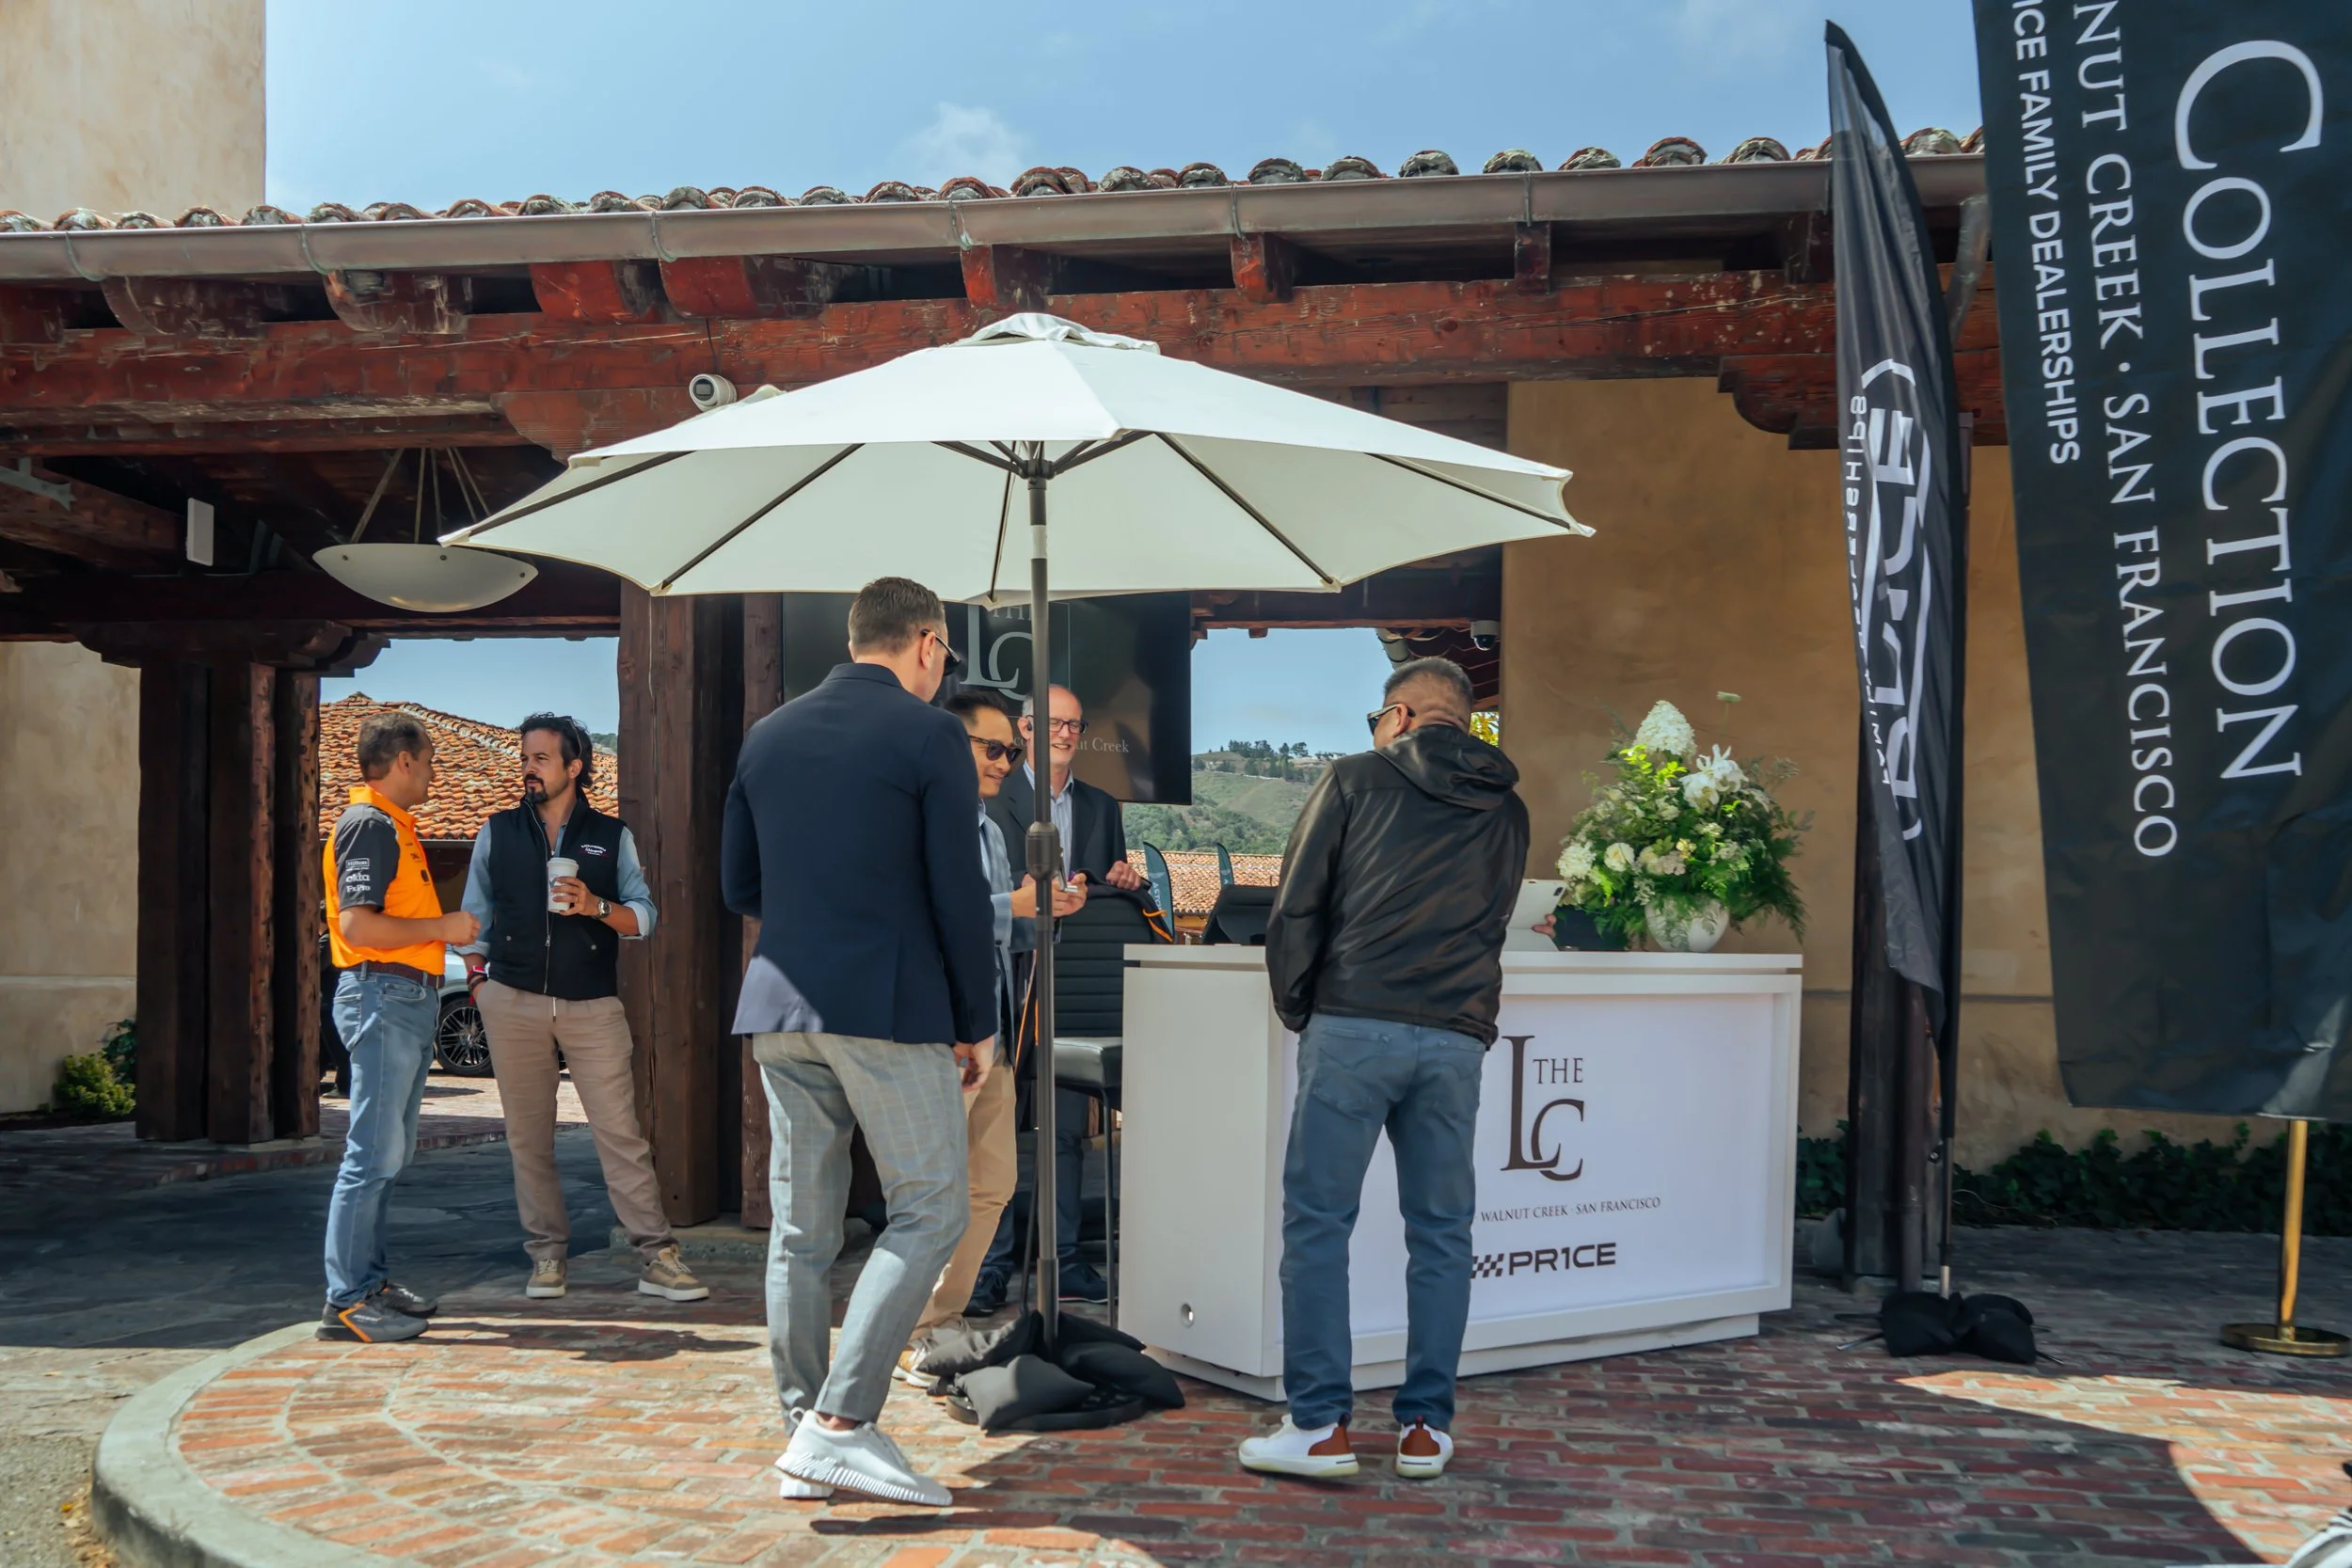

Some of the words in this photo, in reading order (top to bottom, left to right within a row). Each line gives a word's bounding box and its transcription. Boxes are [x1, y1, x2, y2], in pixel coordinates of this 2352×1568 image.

[2073, 0, 2127, 131] NUT
[2019, 70, 2058, 200] FAMILY
[2086, 153, 2143, 350] CREEK
[2029, 210, 2081, 465] DEALERSHIPS
[2105, 393, 2155, 504] SAN
[2174, 40, 2324, 779] COLLECTION
[1091, 736, 1130, 753] Creek
[2114, 526, 2178, 857] FRANCISCO
[1533, 1057, 1584, 1085] THE
[1481, 1207, 1530, 1223] WALNUT
[1533, 1205, 1568, 1219] CREEK
[1575, 1201, 1597, 1215] SAN
[1600, 1196, 1661, 1213] FRANCISCO
